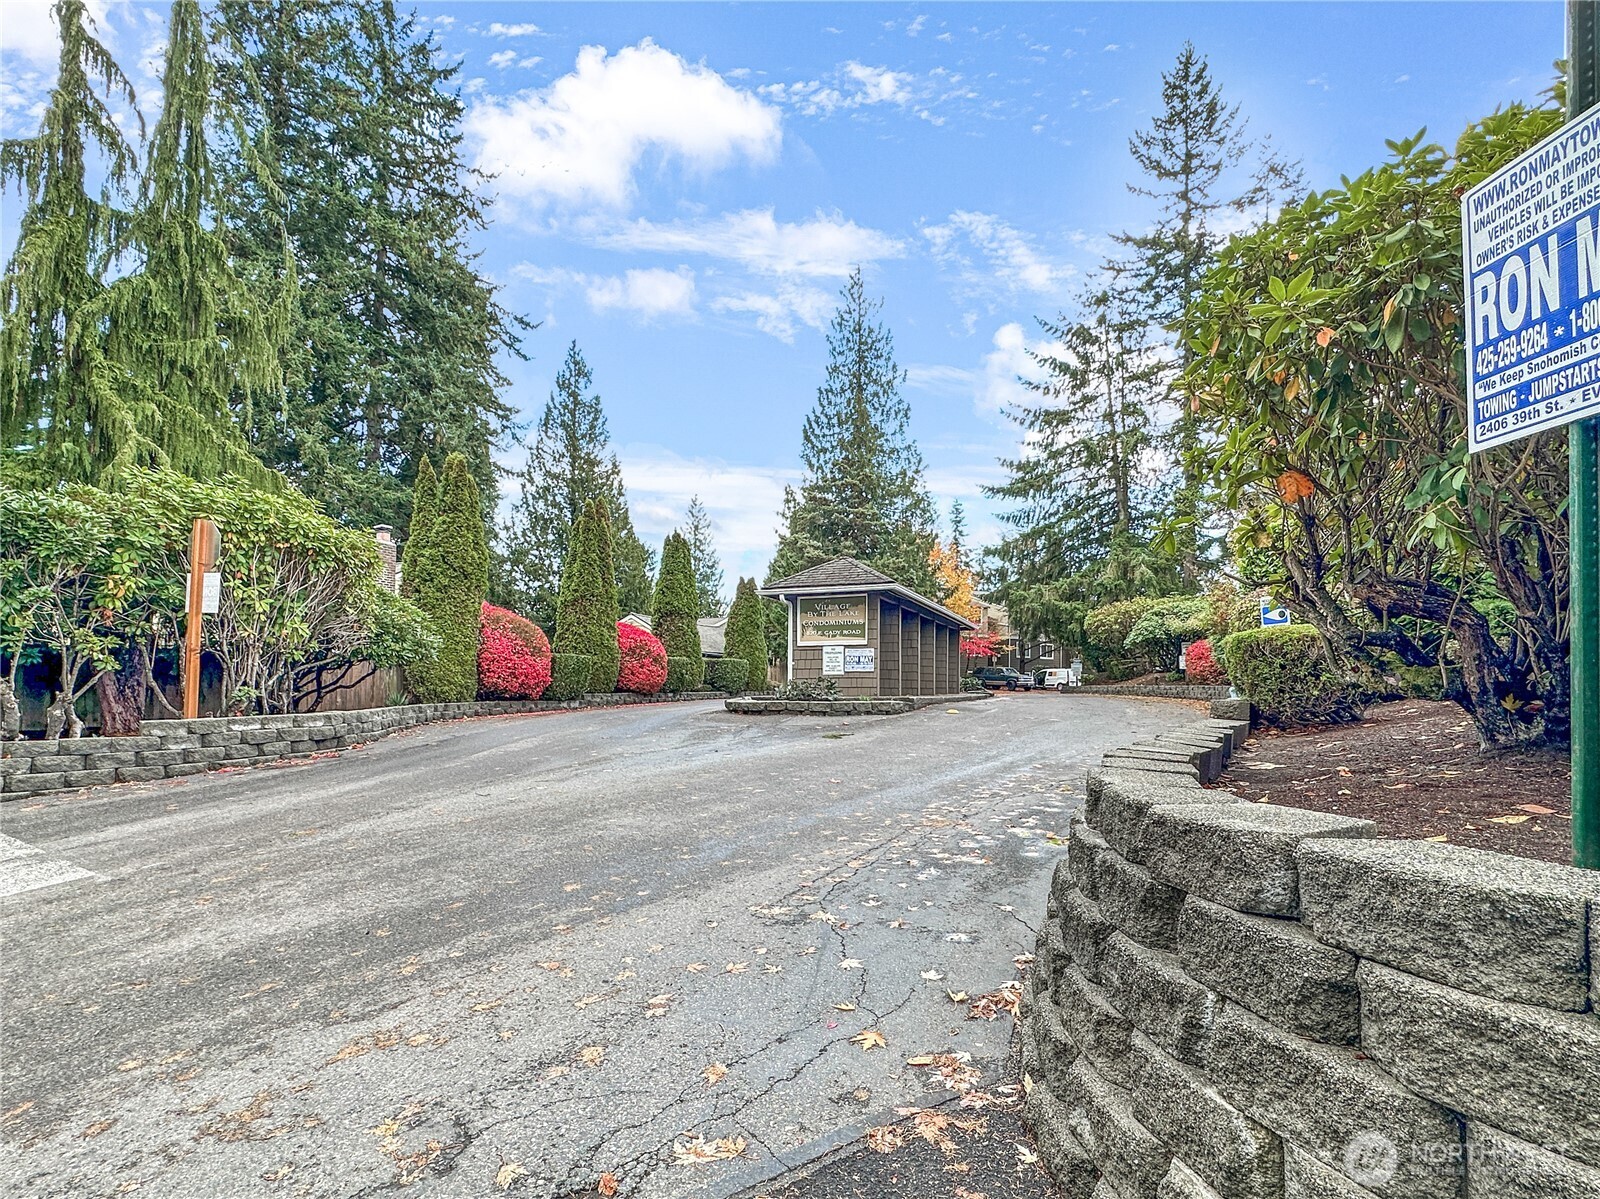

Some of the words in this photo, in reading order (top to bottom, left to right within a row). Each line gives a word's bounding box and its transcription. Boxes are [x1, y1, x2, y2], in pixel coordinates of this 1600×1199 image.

[1473, 181, 1543, 234] UNAUTHORIZED
[1545, 169, 1560, 189] OR
[1488, 205, 1532, 243] VEHICLES
[1533, 191, 1558, 215] WILL
[1560, 180, 1574, 200] BE
[1476, 235, 1515, 268] OWNER'S
[1517, 220, 1539, 244] RISK
[1542, 215, 1549, 230] &
[1552, 184, 1600, 225] EXPENSE
[1473, 232, 1561, 347] RON
[1475, 321, 1549, 377] 425-259-9264
[1569, 297, 1600, 338] 1-80
[1478, 380, 1497, 393] "We
[1499, 369, 1524, 386] Keep
[1527, 342, 1587, 375] Snohomish
[1591, 335, 1600, 350] C
[1477, 389, 1517, 421] TOWING
[1479, 416, 1508, 437] 2406
[1512, 406, 1541, 426] 39th
[1545, 399, 1564, 415] St.
[802, 619, 864, 627] CONDOMINIUMS
[814, 603, 851, 611] VILLAGE
[820, 610, 837, 618] THE
[845, 655, 860, 664] RON
[860, 654, 874, 663] MAY
